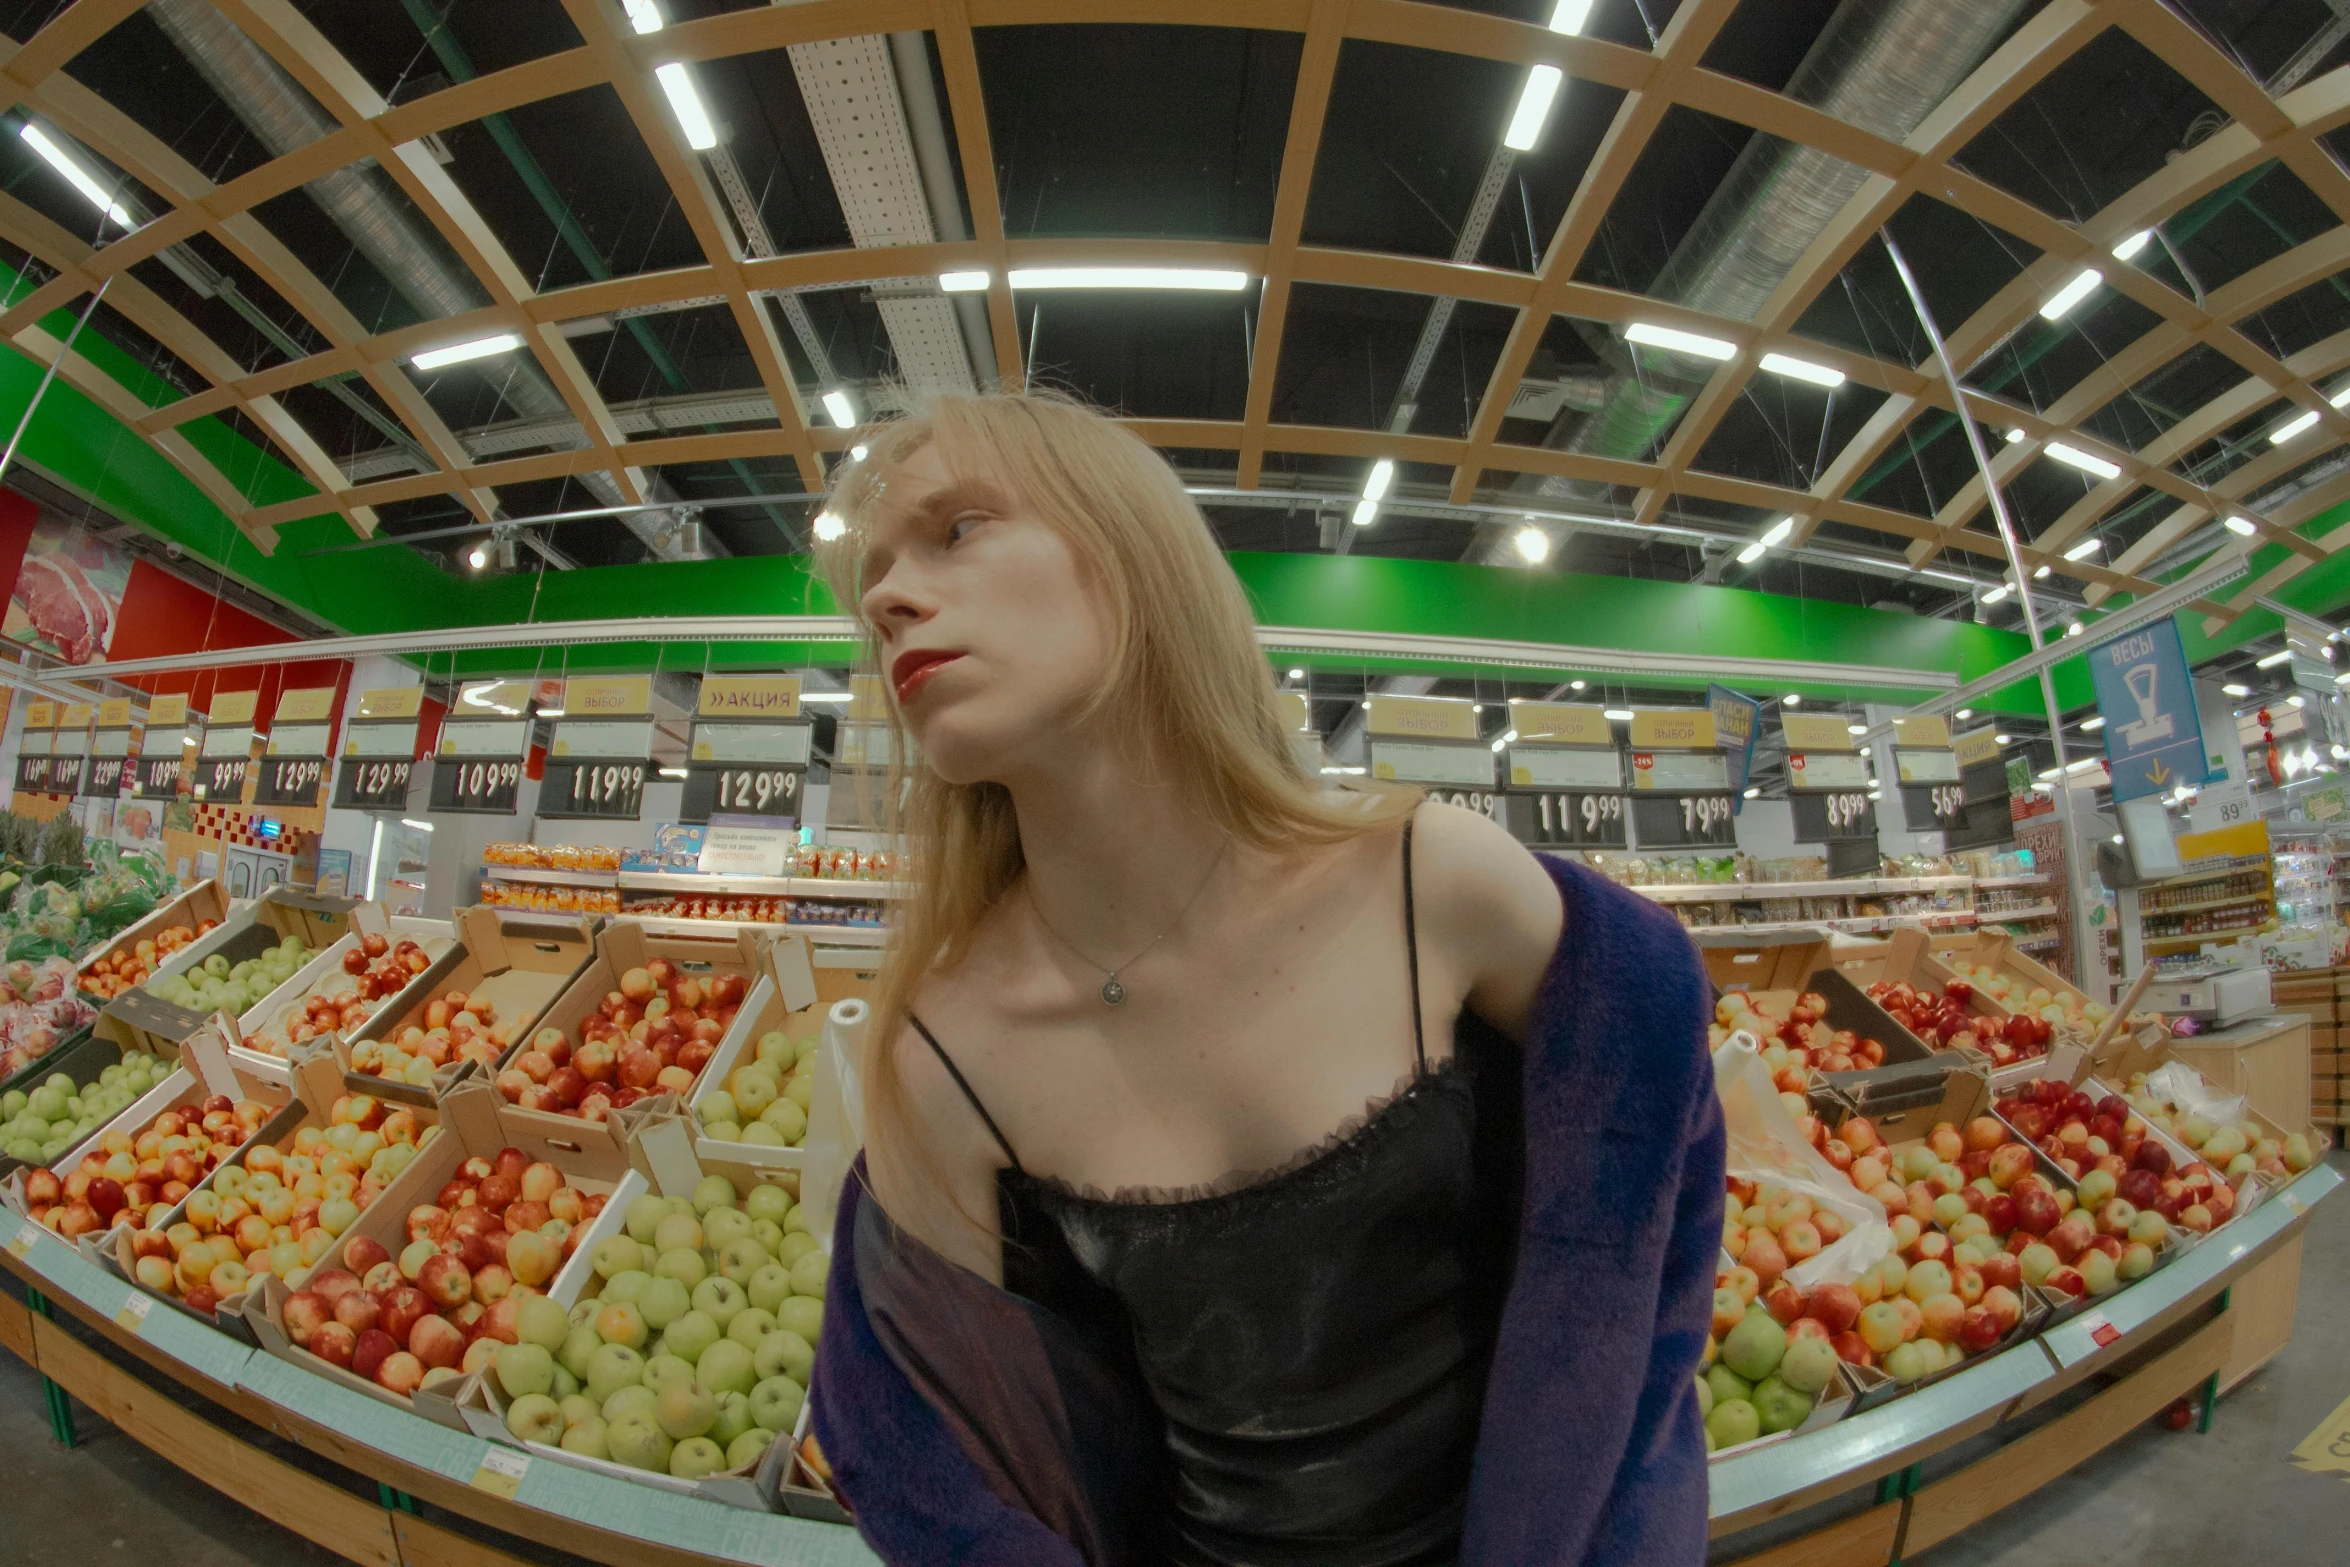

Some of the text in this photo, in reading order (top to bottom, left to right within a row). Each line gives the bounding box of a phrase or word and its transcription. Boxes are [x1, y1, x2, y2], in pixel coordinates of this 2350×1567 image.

[2111, 631, 2155, 667] ВЕСЫ
[372, 702, 402, 713] ВЫБОР
[584, 697, 626, 708] ВЫБОР
[726, 691, 791, 710] АКЦИЯ
[1397, 707, 1449, 719] ОТЛИЧНЫЙ
[1536, 713, 1584, 724] ОТЛИЧНЫЙ
[1397, 717, 1449, 731] ВЫБОР
[1537, 723, 1584, 735] ВЫБОР
[1653, 718, 1694, 728] ОТЛИЧНЫЙ
[1714, 715, 1749, 737] АНАН
[1653, 728, 1695, 739] ВЫБОР
[1803, 733, 1835, 743] ВЫБОР
[2020, 831, 2056, 851] ОРЕХИ
[2098, 929, 2107, 966] ОРЕХИ
[530, 1488, 592, 1520] ДЕНЬГИ
[650, 1491, 728, 1523] ВЫСОКОЕ
[721, 1527, 840, 1567] СВЕЖЕЕ
